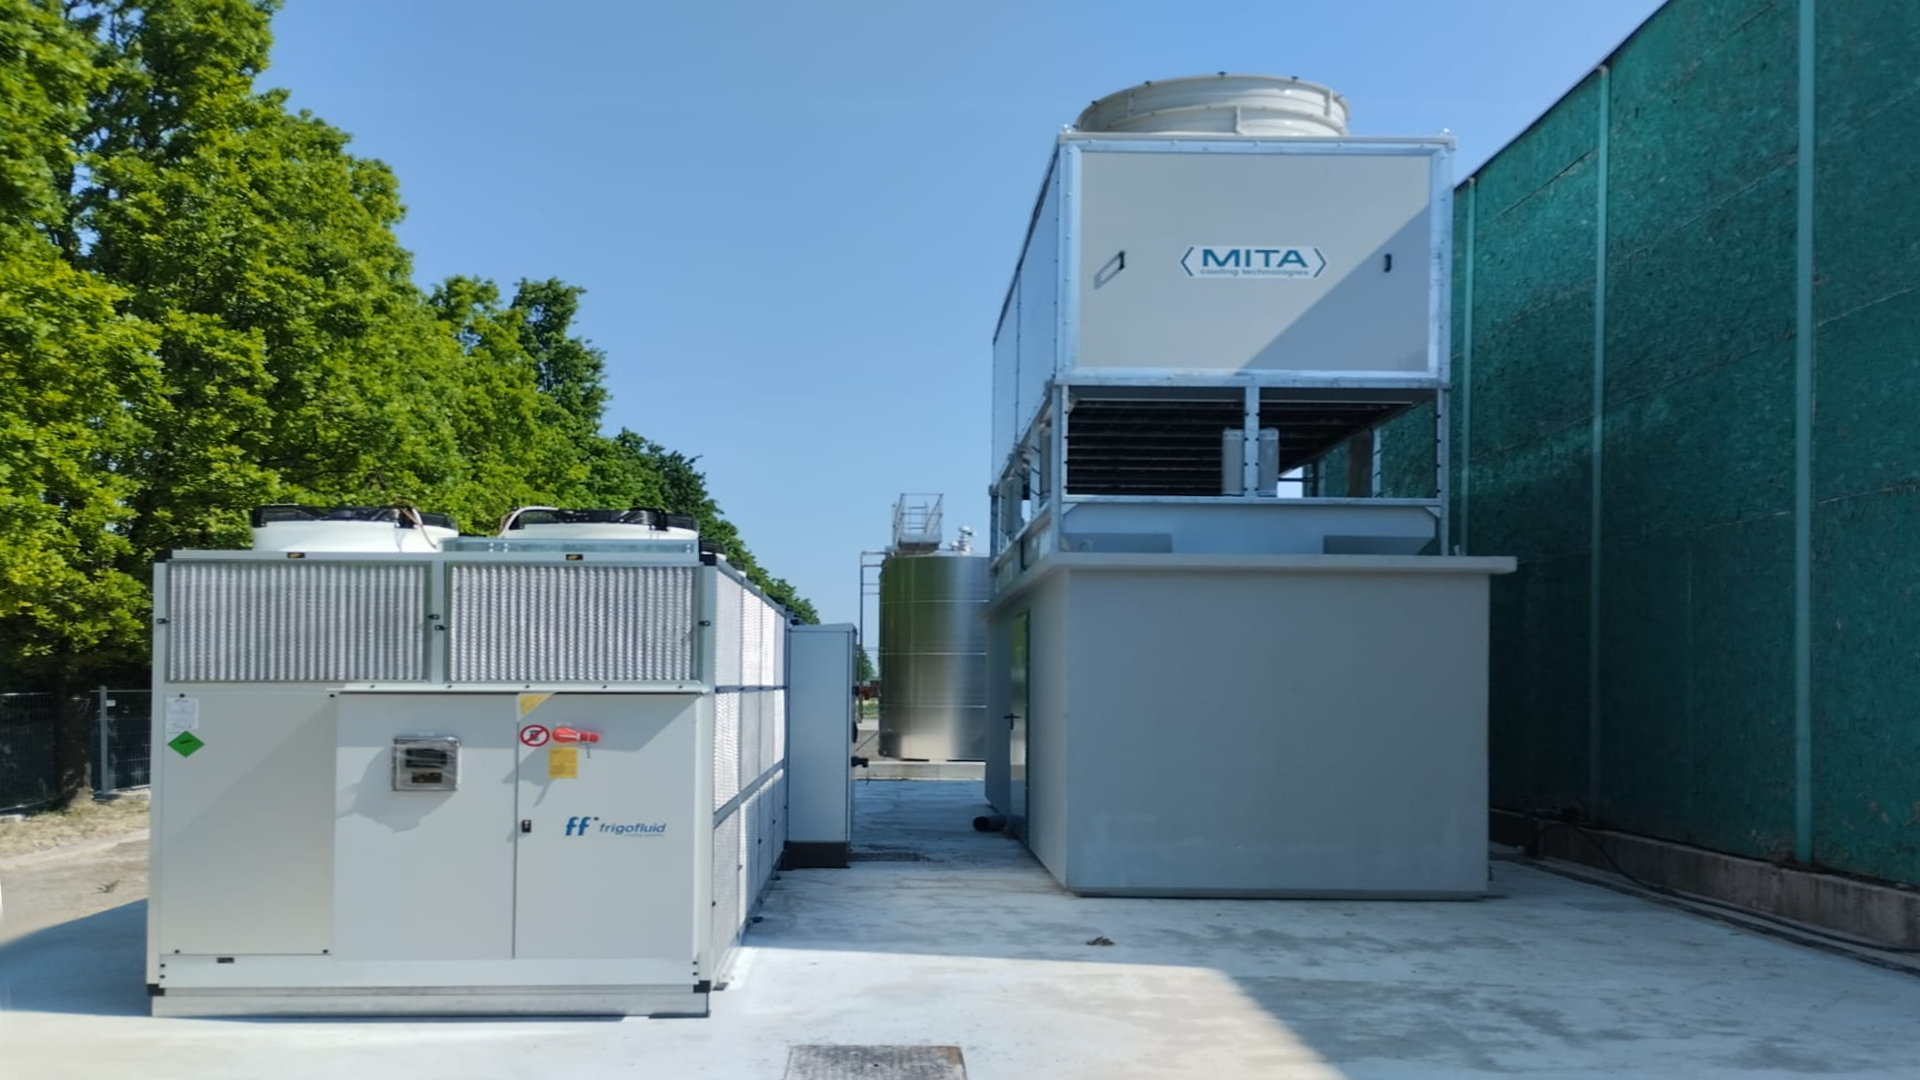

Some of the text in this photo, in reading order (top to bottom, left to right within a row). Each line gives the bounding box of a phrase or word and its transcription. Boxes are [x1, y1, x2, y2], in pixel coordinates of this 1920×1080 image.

[1202, 249, 1309, 268] MITA
[1200, 268, 1240, 277] cooling
[600, 823, 666, 835] frigofluid
